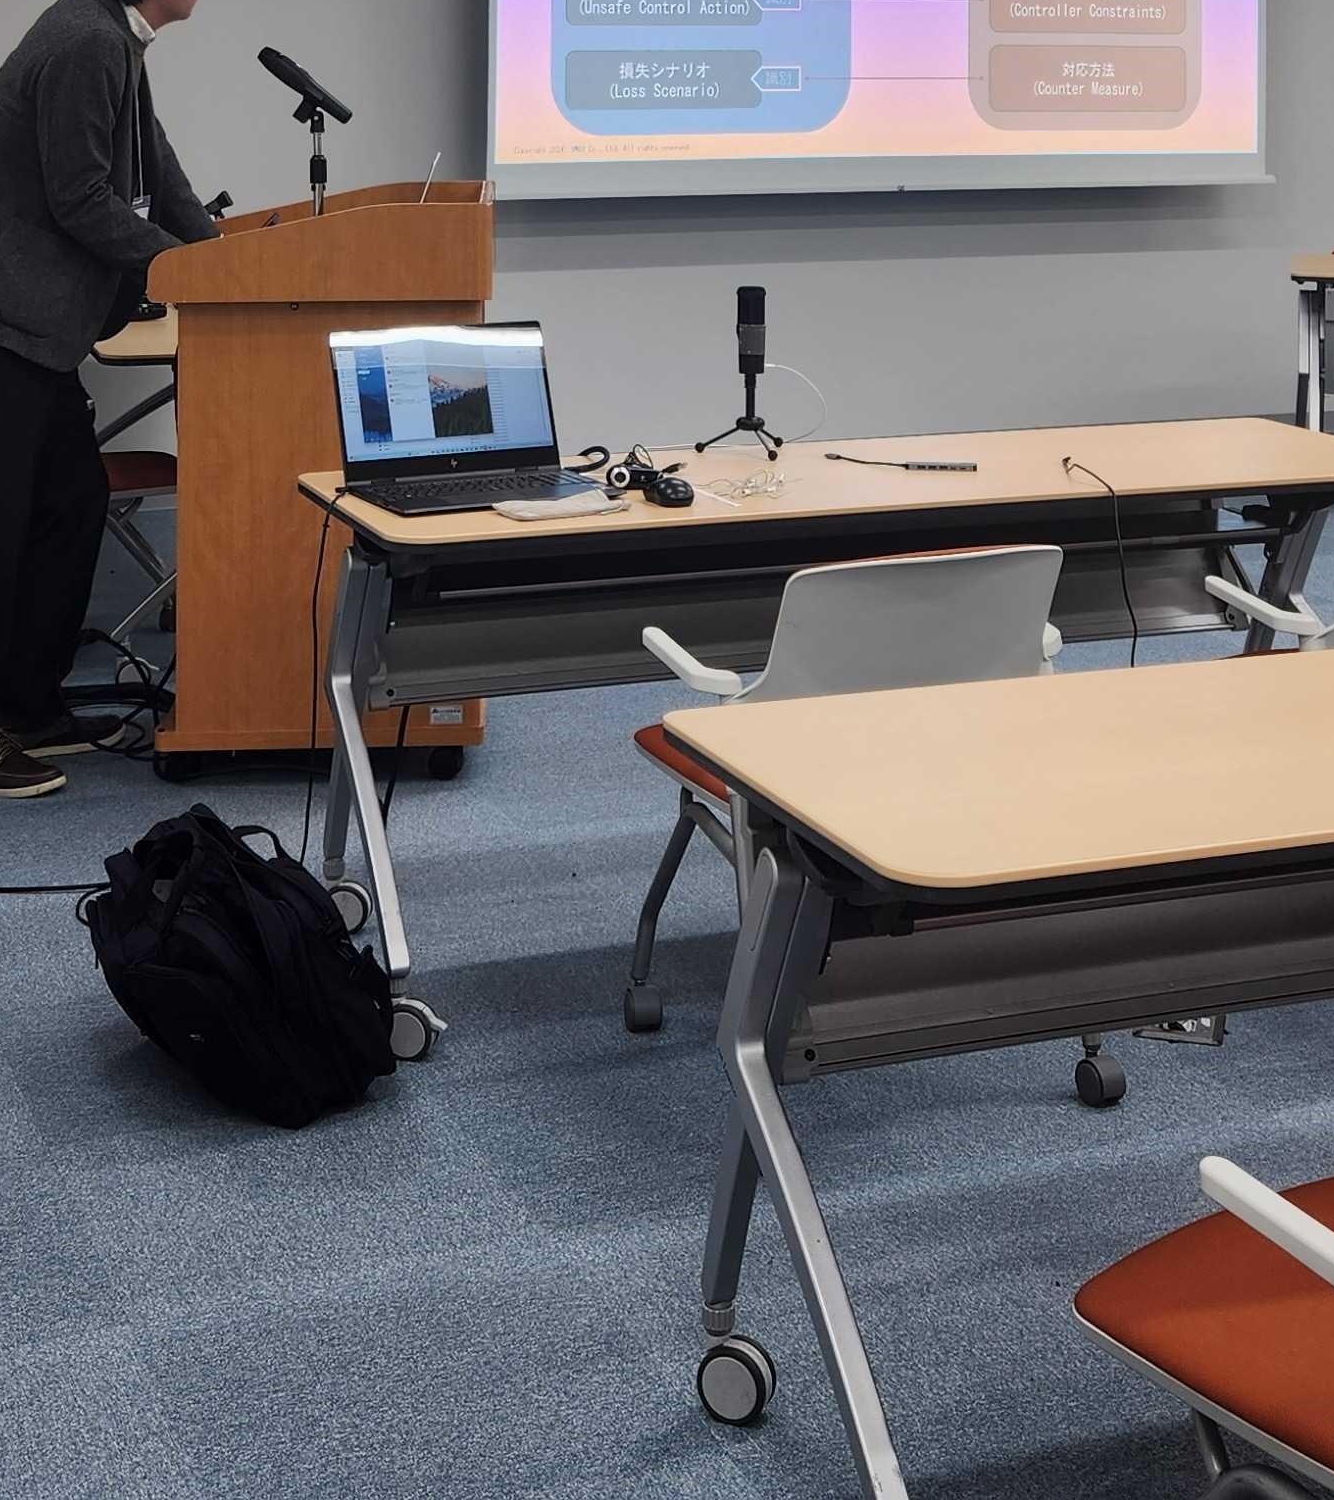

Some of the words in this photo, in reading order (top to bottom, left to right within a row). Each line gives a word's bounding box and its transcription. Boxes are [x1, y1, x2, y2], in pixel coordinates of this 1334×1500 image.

[579, 0, 631, 15] (Unsafe
[639, 0, 691, 14] Control
[700, 0, 750, 15] Action)
[1010, 2, 1082, 18] (Controller
[1089, 3, 1166, 19] Constraints)
[619, 62, 710, 79] 損失シナリオ
[1062, 63, 1116, 78] 対応方法
[609, 82, 646, 100] (Loss
[653, 82, 720, 99] Scenario)
[1033, 81, 1085, 97] (Counter
[1091, 81, 1143, 97] Measure)
